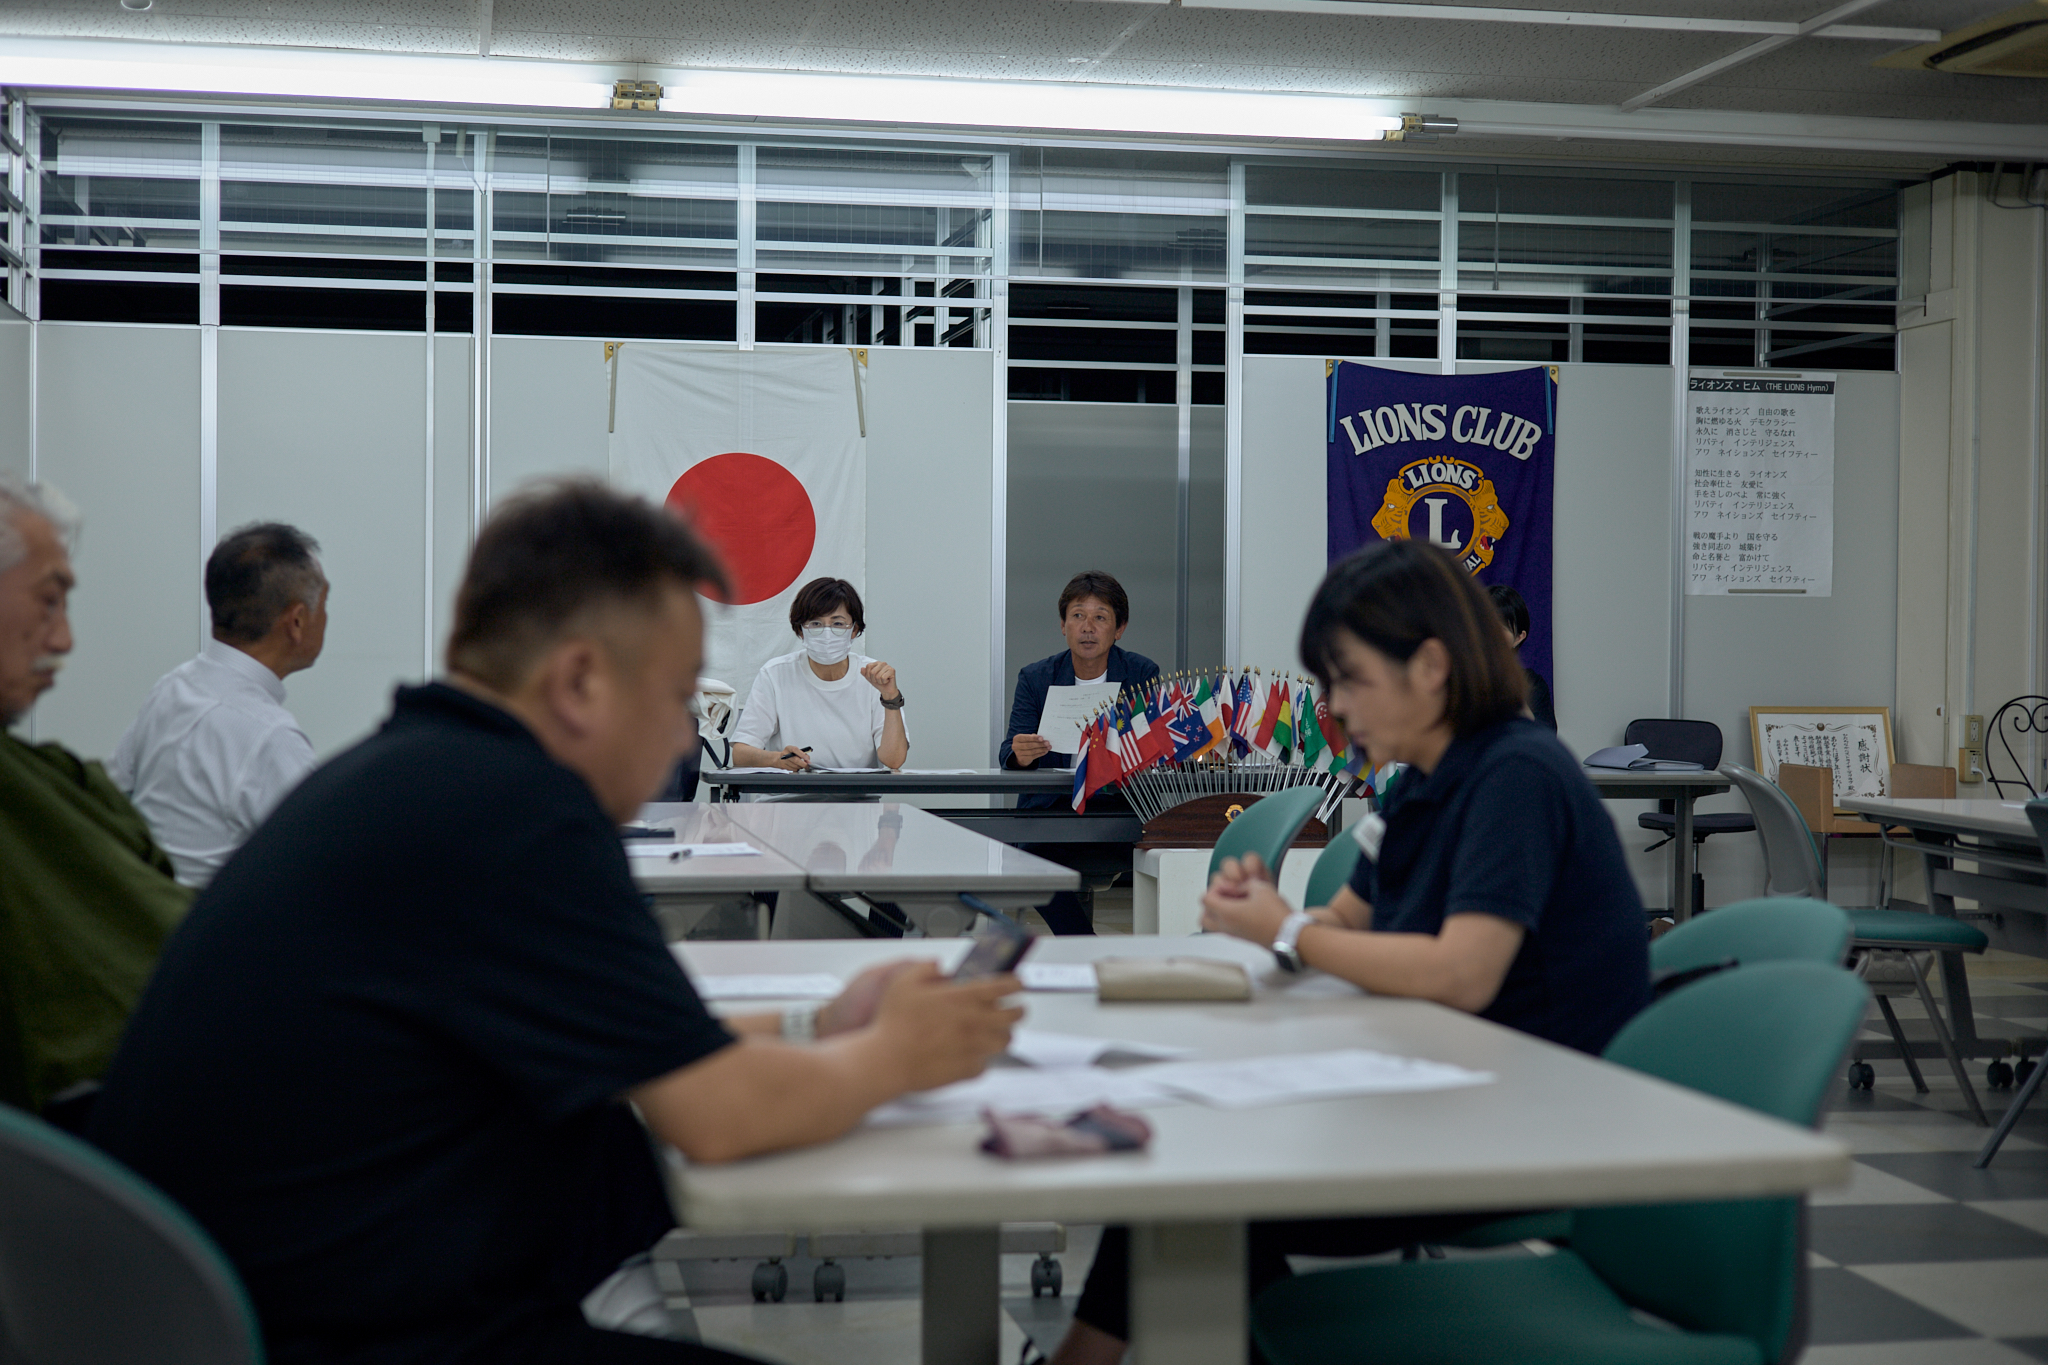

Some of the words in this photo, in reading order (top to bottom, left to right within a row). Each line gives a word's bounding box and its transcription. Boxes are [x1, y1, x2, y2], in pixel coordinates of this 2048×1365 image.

[1690, 380, 1760, 391] ライオンズ・ヒム
[1784, 383, 1805, 391] LIONS
[1696, 406, 1750, 415] 歌えライオンズ
[1758, 407, 1796, 417] 自由の歌を
[1750, 418, 1796, 427] デモクラシー
[1340, 403, 1447, 456] LIONS
[1452, 405, 1542, 461] CLUB
[1695, 427, 1718, 436] 永久に
[1765, 428, 1796, 437] 守るなれ
[1734, 439, 1795, 448] インテリジェンス
[1695, 448, 1710, 456] アワ
[1718, 449, 1765, 457] ネイションズ
[1772, 450, 1818, 459] セイフティー
[1405, 463, 1478, 489] LIONS
[1694, 469, 1741, 478] 知性に生きる
[1749, 470, 1788, 479] ライオンズ
[1694, 479, 1732, 488] 社会奉仕と
[1741, 480, 1763, 488] 友愛に
[1756, 491, 1786, 499] 常に強く
[1733, 501, 1794, 510] インテリジェンス
[1694, 510, 1709, 518] アワ
[1717, 511, 1763, 519] ネイションズ
[1771, 512, 1817, 521] セイフティー
[1424, 498, 1462, 550] L
[1747, 533, 1778, 541] 国を守る
[1692, 542, 1731, 551] 強き同志の
[1731, 564, 1792, 573] インテリジェンス
[1691, 573, 1707, 581] アワ
[1715, 574, 1762, 583] ネイションズ
[1769, 575, 1815, 584] セイフティー
[1858, 738, 1872, 773] 感謝状
